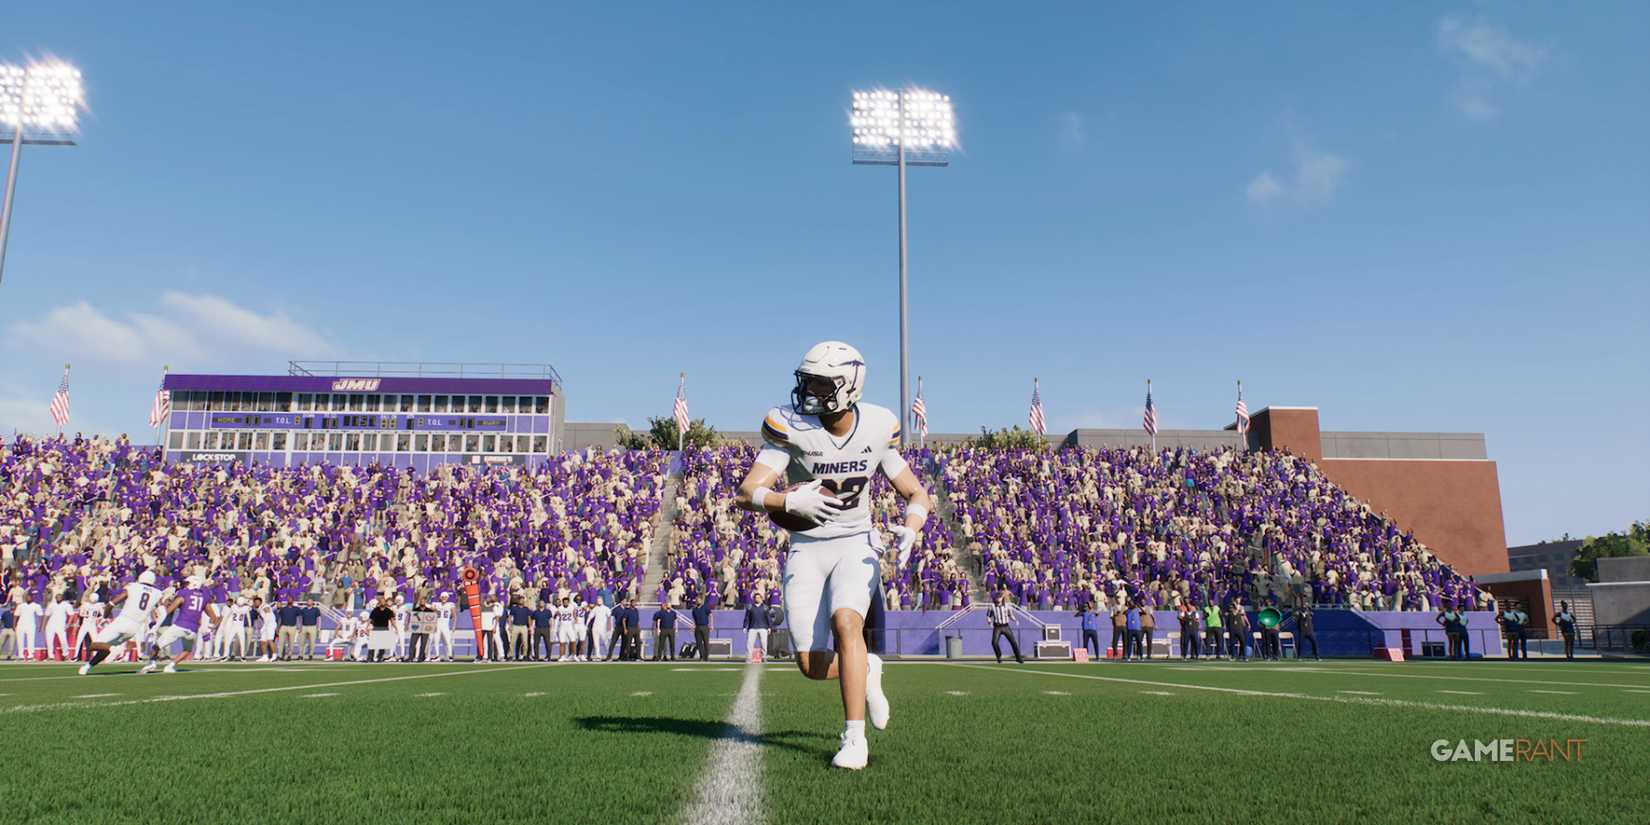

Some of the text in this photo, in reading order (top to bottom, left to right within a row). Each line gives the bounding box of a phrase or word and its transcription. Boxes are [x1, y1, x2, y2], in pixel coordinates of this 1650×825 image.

[332, 378, 382, 391] JMU
[812, 459, 868, 474] MINERS
[138, 592, 151, 610] 8
[188, 595, 204, 611] 31
